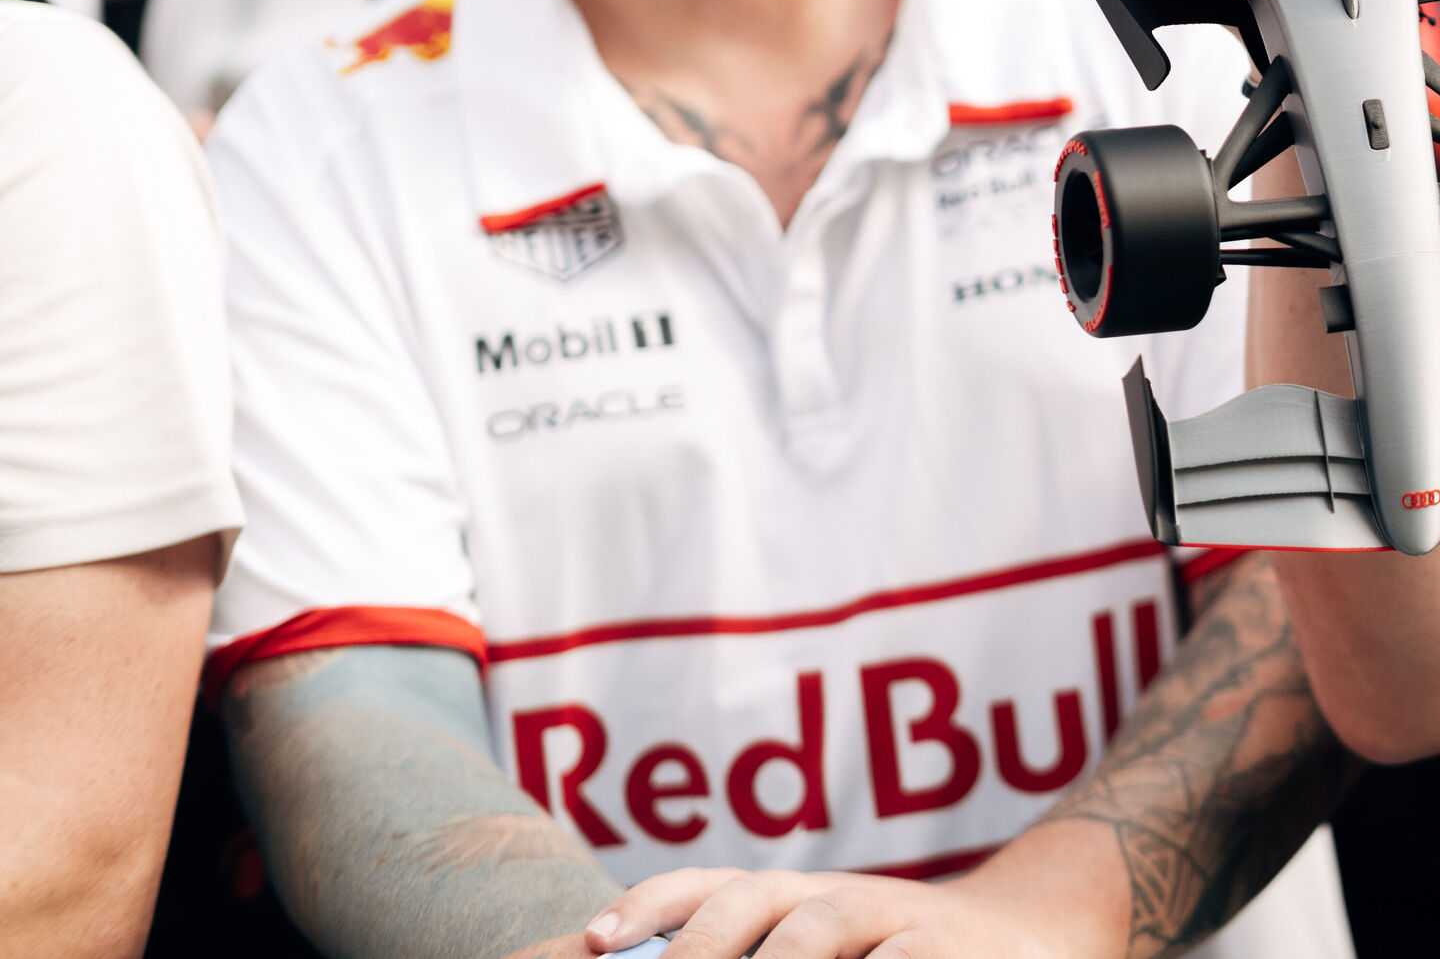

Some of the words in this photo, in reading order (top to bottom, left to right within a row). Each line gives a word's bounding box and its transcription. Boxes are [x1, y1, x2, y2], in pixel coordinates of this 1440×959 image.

[952, 263, 1060, 305] HON
[475, 319, 618, 374] Mobil
[486, 383, 686, 442] ORACLE
[511, 669, 831, 850] Red
[858, 597, 1163, 821] Bull
